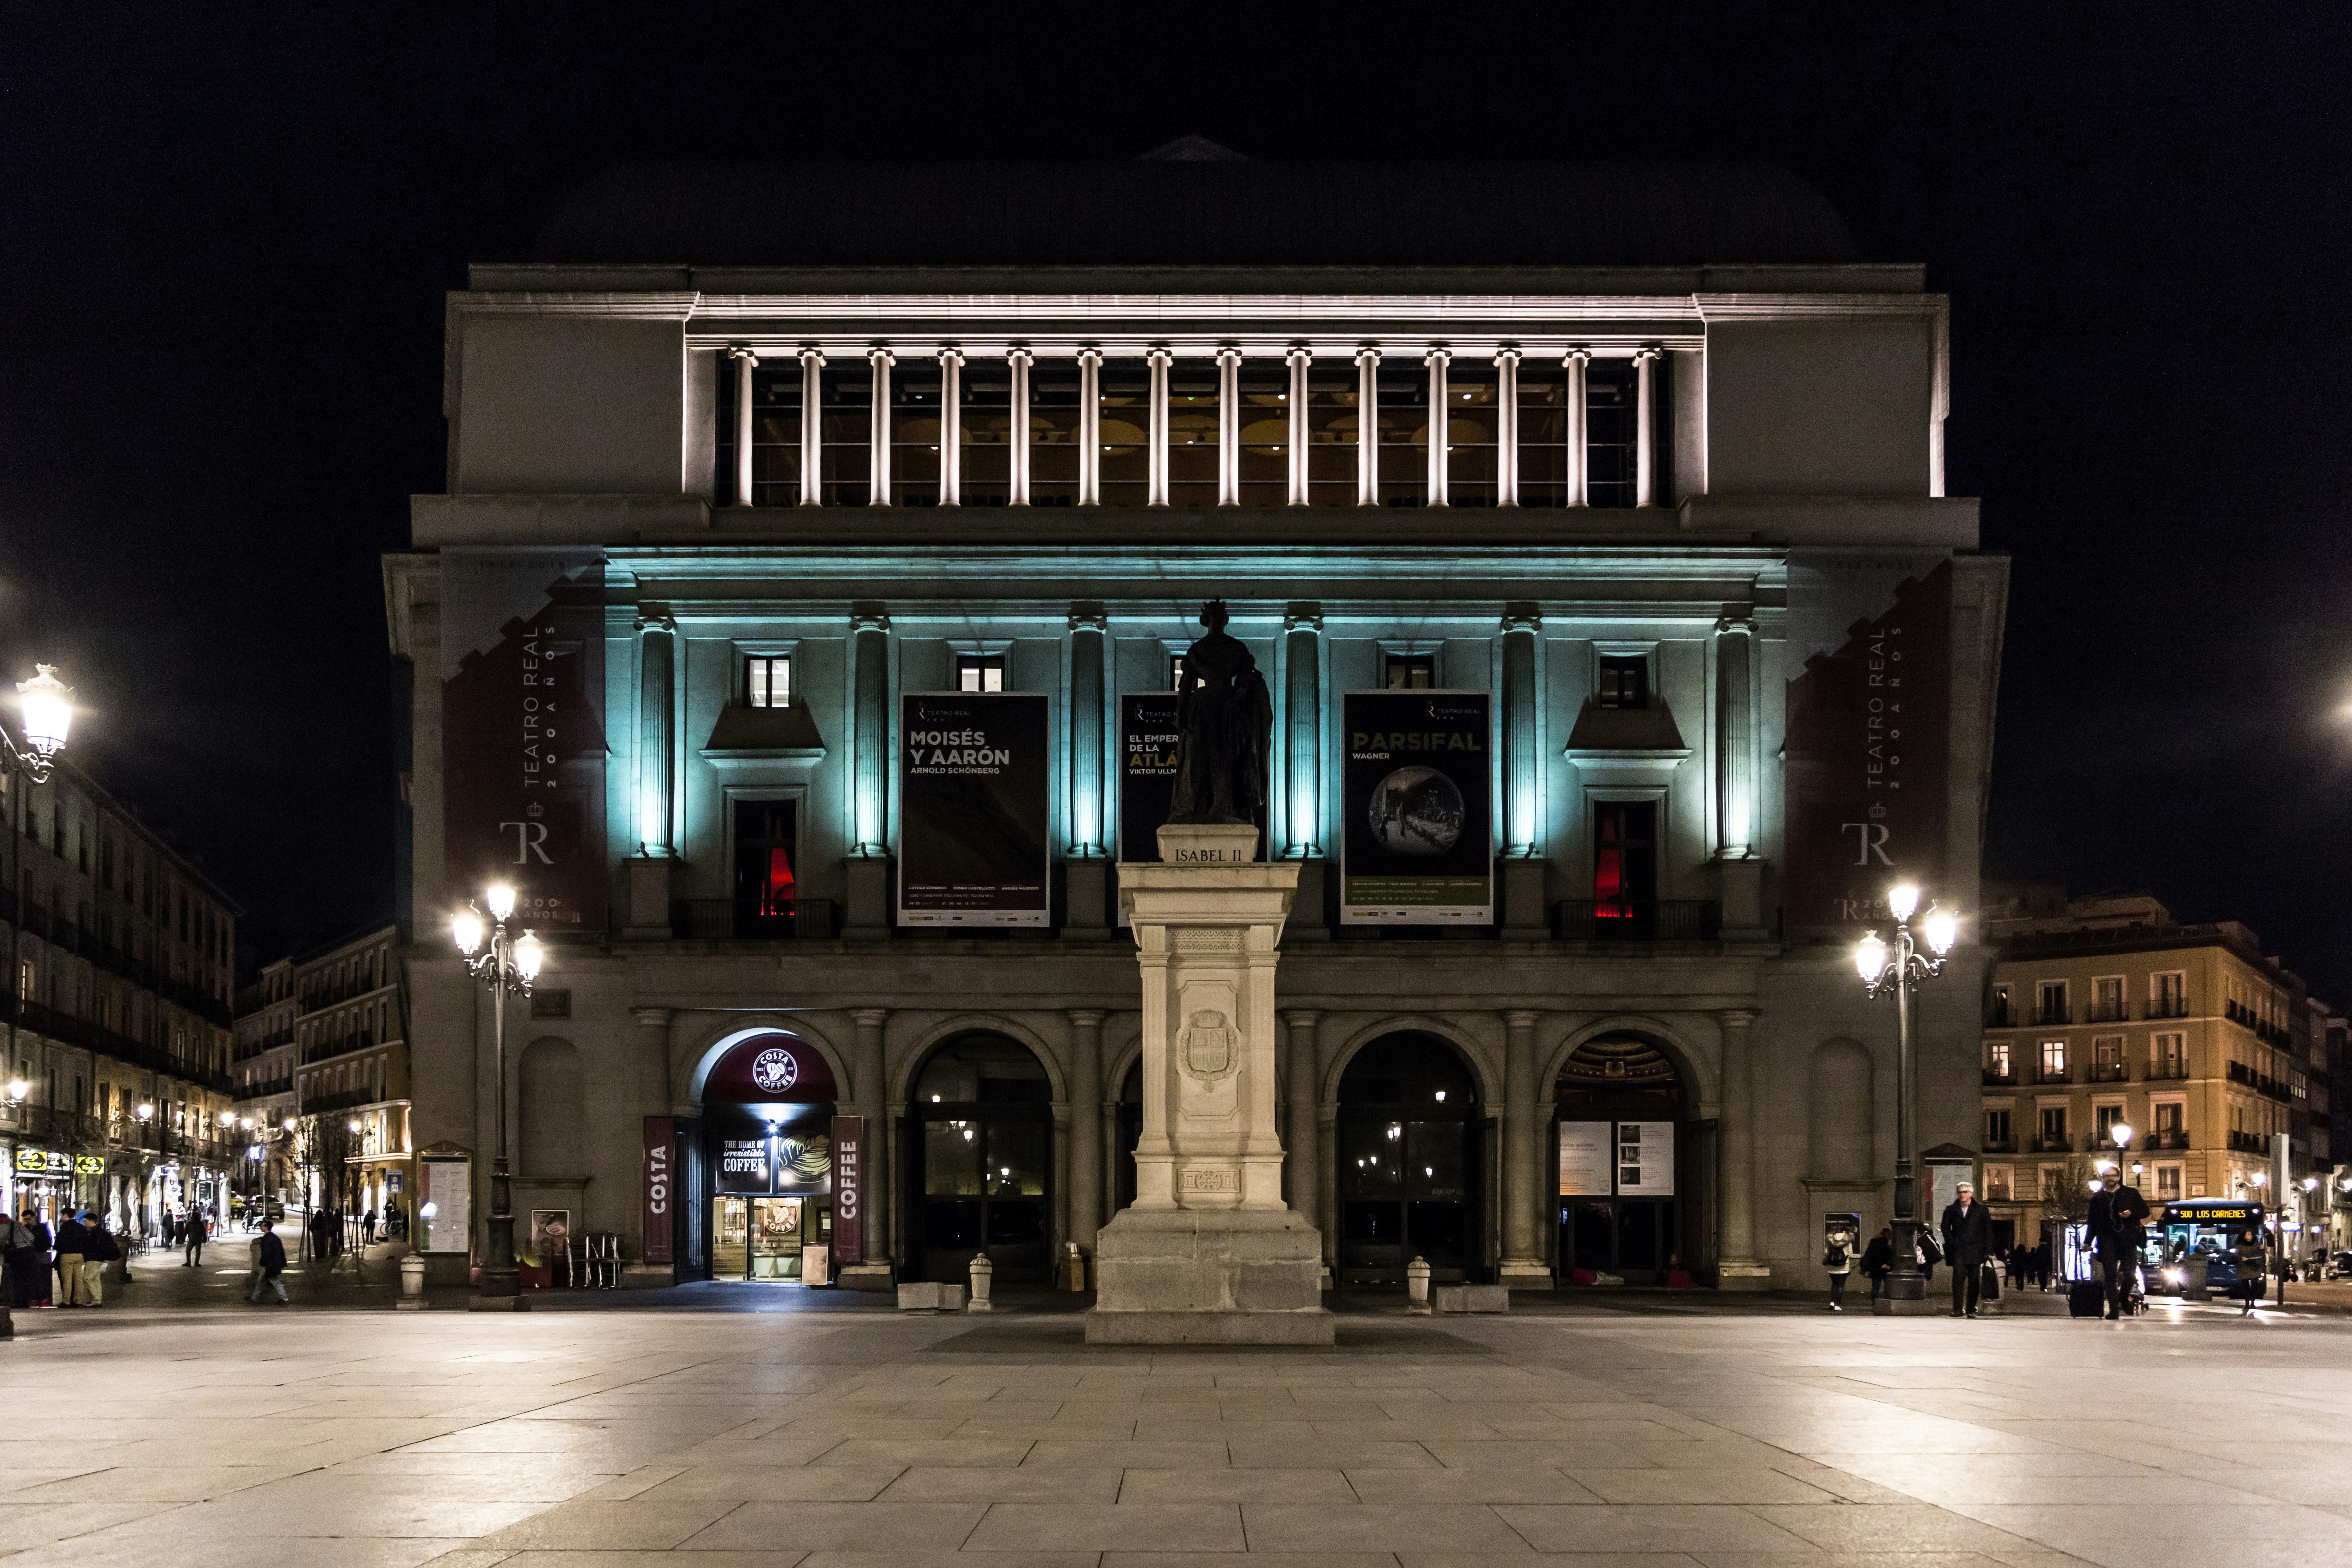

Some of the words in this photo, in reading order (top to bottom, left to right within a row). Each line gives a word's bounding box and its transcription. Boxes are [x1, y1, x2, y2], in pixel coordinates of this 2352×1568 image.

[522, 626, 540, 686] REAL
[1869, 628, 1886, 687] REAL
[523, 696, 540, 788] TEATRO
[910, 728, 985, 746] MOISÉS
[1353, 732, 1482, 751] PARSIFAL
[1868, 697, 1885, 789] TEATRO
[910, 749, 925, 765] Y
[930, 745, 1009, 765] AARÓN
[1129, 750, 1177, 766] ATLÁ
[948, 766, 1000, 774] SCHÖNBERG
[1176, 849, 1226, 862] ISABEL
[1232, 850, 1241, 861] II
[1862, 899, 1884, 909] 20
[1862, 910, 1890, 920] AÑO
[760, 1052, 789, 1064] COSTA
[758, 1075, 793, 1089] COFFEE
[723, 1149, 766, 1157] irresistible
[724, 1158, 765, 1172] COFFEE
[650, 1146, 668, 1214] COSTA
[840, 1141, 857, 1219] COFFEE
[766, 1218, 795, 1232] COFFEE
